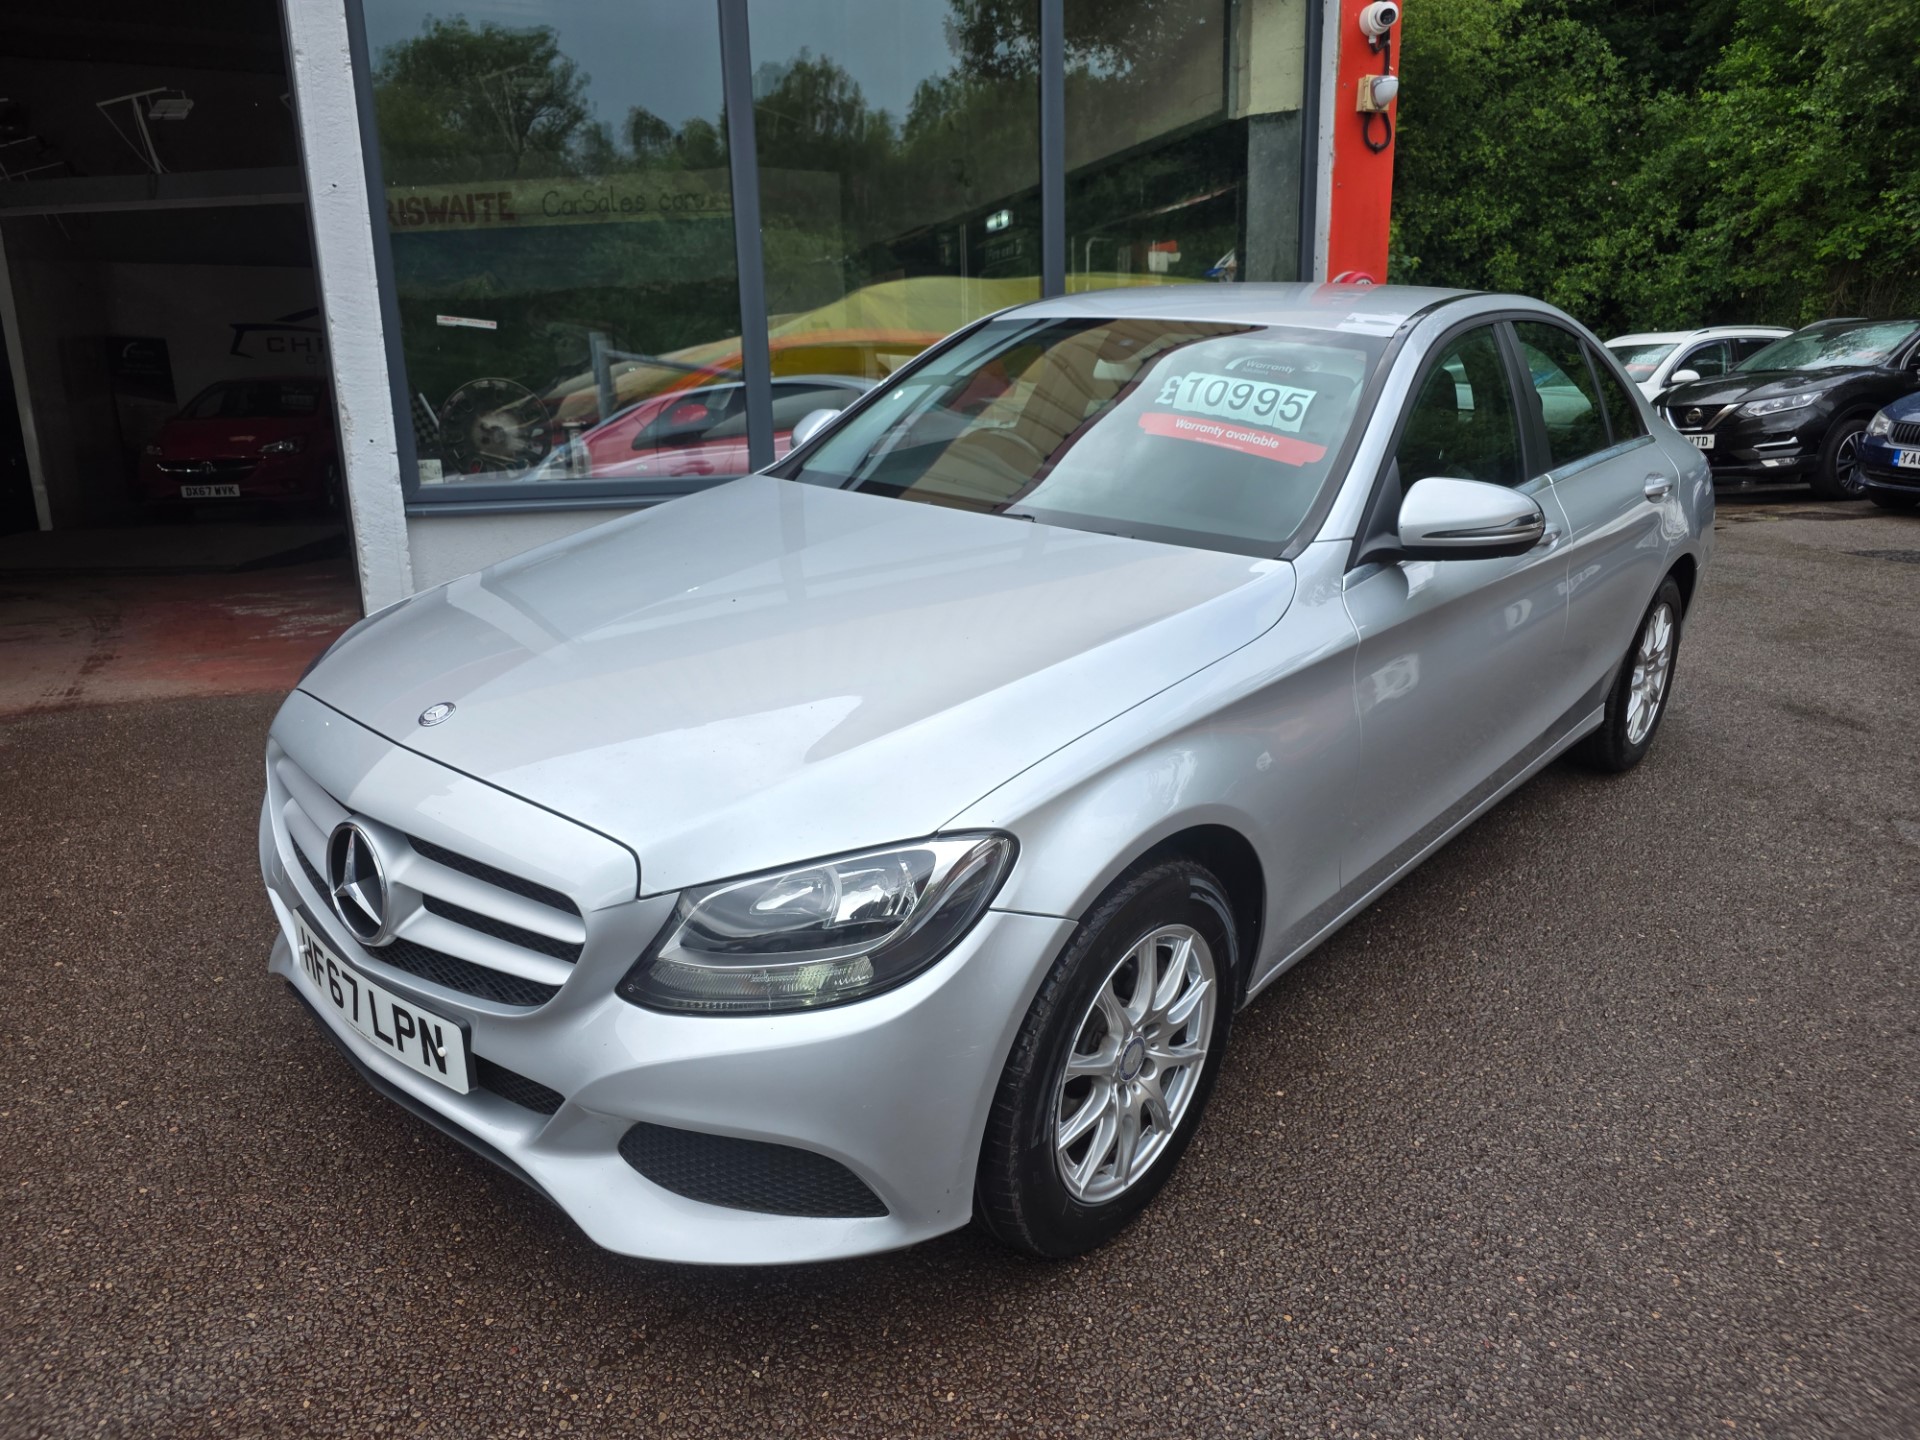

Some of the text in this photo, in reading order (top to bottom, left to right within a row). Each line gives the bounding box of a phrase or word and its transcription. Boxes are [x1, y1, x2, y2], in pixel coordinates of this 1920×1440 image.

[1246, 359, 1296, 374] Warranty
[1154, 375, 1308, 422] £10995
[1175, 418, 1225, 438] Warranty
[1225, 428, 1280, 449] available
[1902, 451, 1920, 465] YA
[184, 485, 236, 497] DX67 WVK
[301, 926, 447, 1075] HF67 LPN
